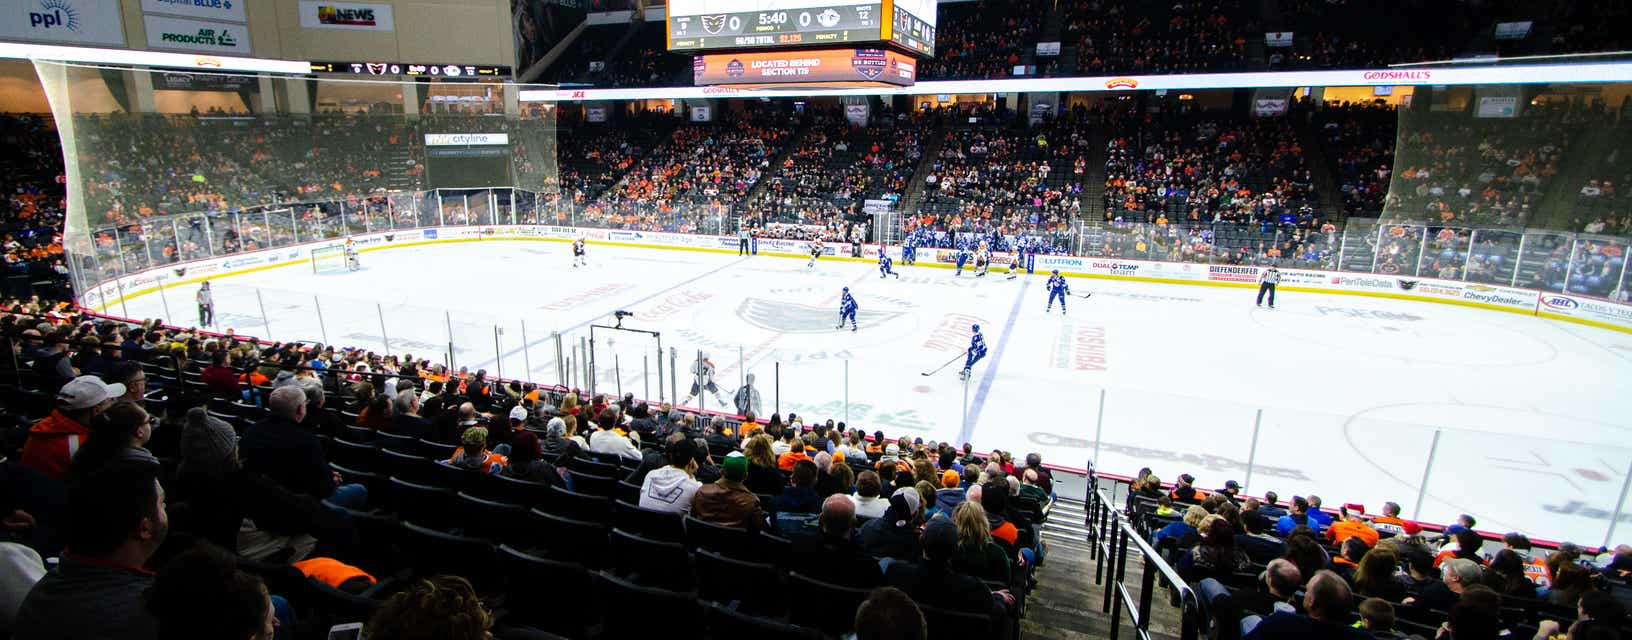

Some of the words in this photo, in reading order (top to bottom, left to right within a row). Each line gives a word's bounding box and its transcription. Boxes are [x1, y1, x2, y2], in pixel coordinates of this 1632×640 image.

[30, 10, 62, 28] ppl
[336, 8, 375, 21] NEWS
[759, 12, 787, 24] 5:40
[799, 12, 812, 27] 0
[859, 11, 869, 19] 12
[729, 16, 740, 31] 0
[199, 28, 216, 37] AIR
[162, 33, 216, 45] PRODUCTS
[752, 60, 788, 68] LOCATED
[790, 58, 820, 67] BEHIND
[761, 67, 796, 76] SECTION
[1363, 71, 1431, 80] GODSHALL'S
[1045, 258, 1083, 266] LUTRON
[1110, 268, 1136, 276] team
[1209, 265, 1258, 275] DIEFENDERFER
